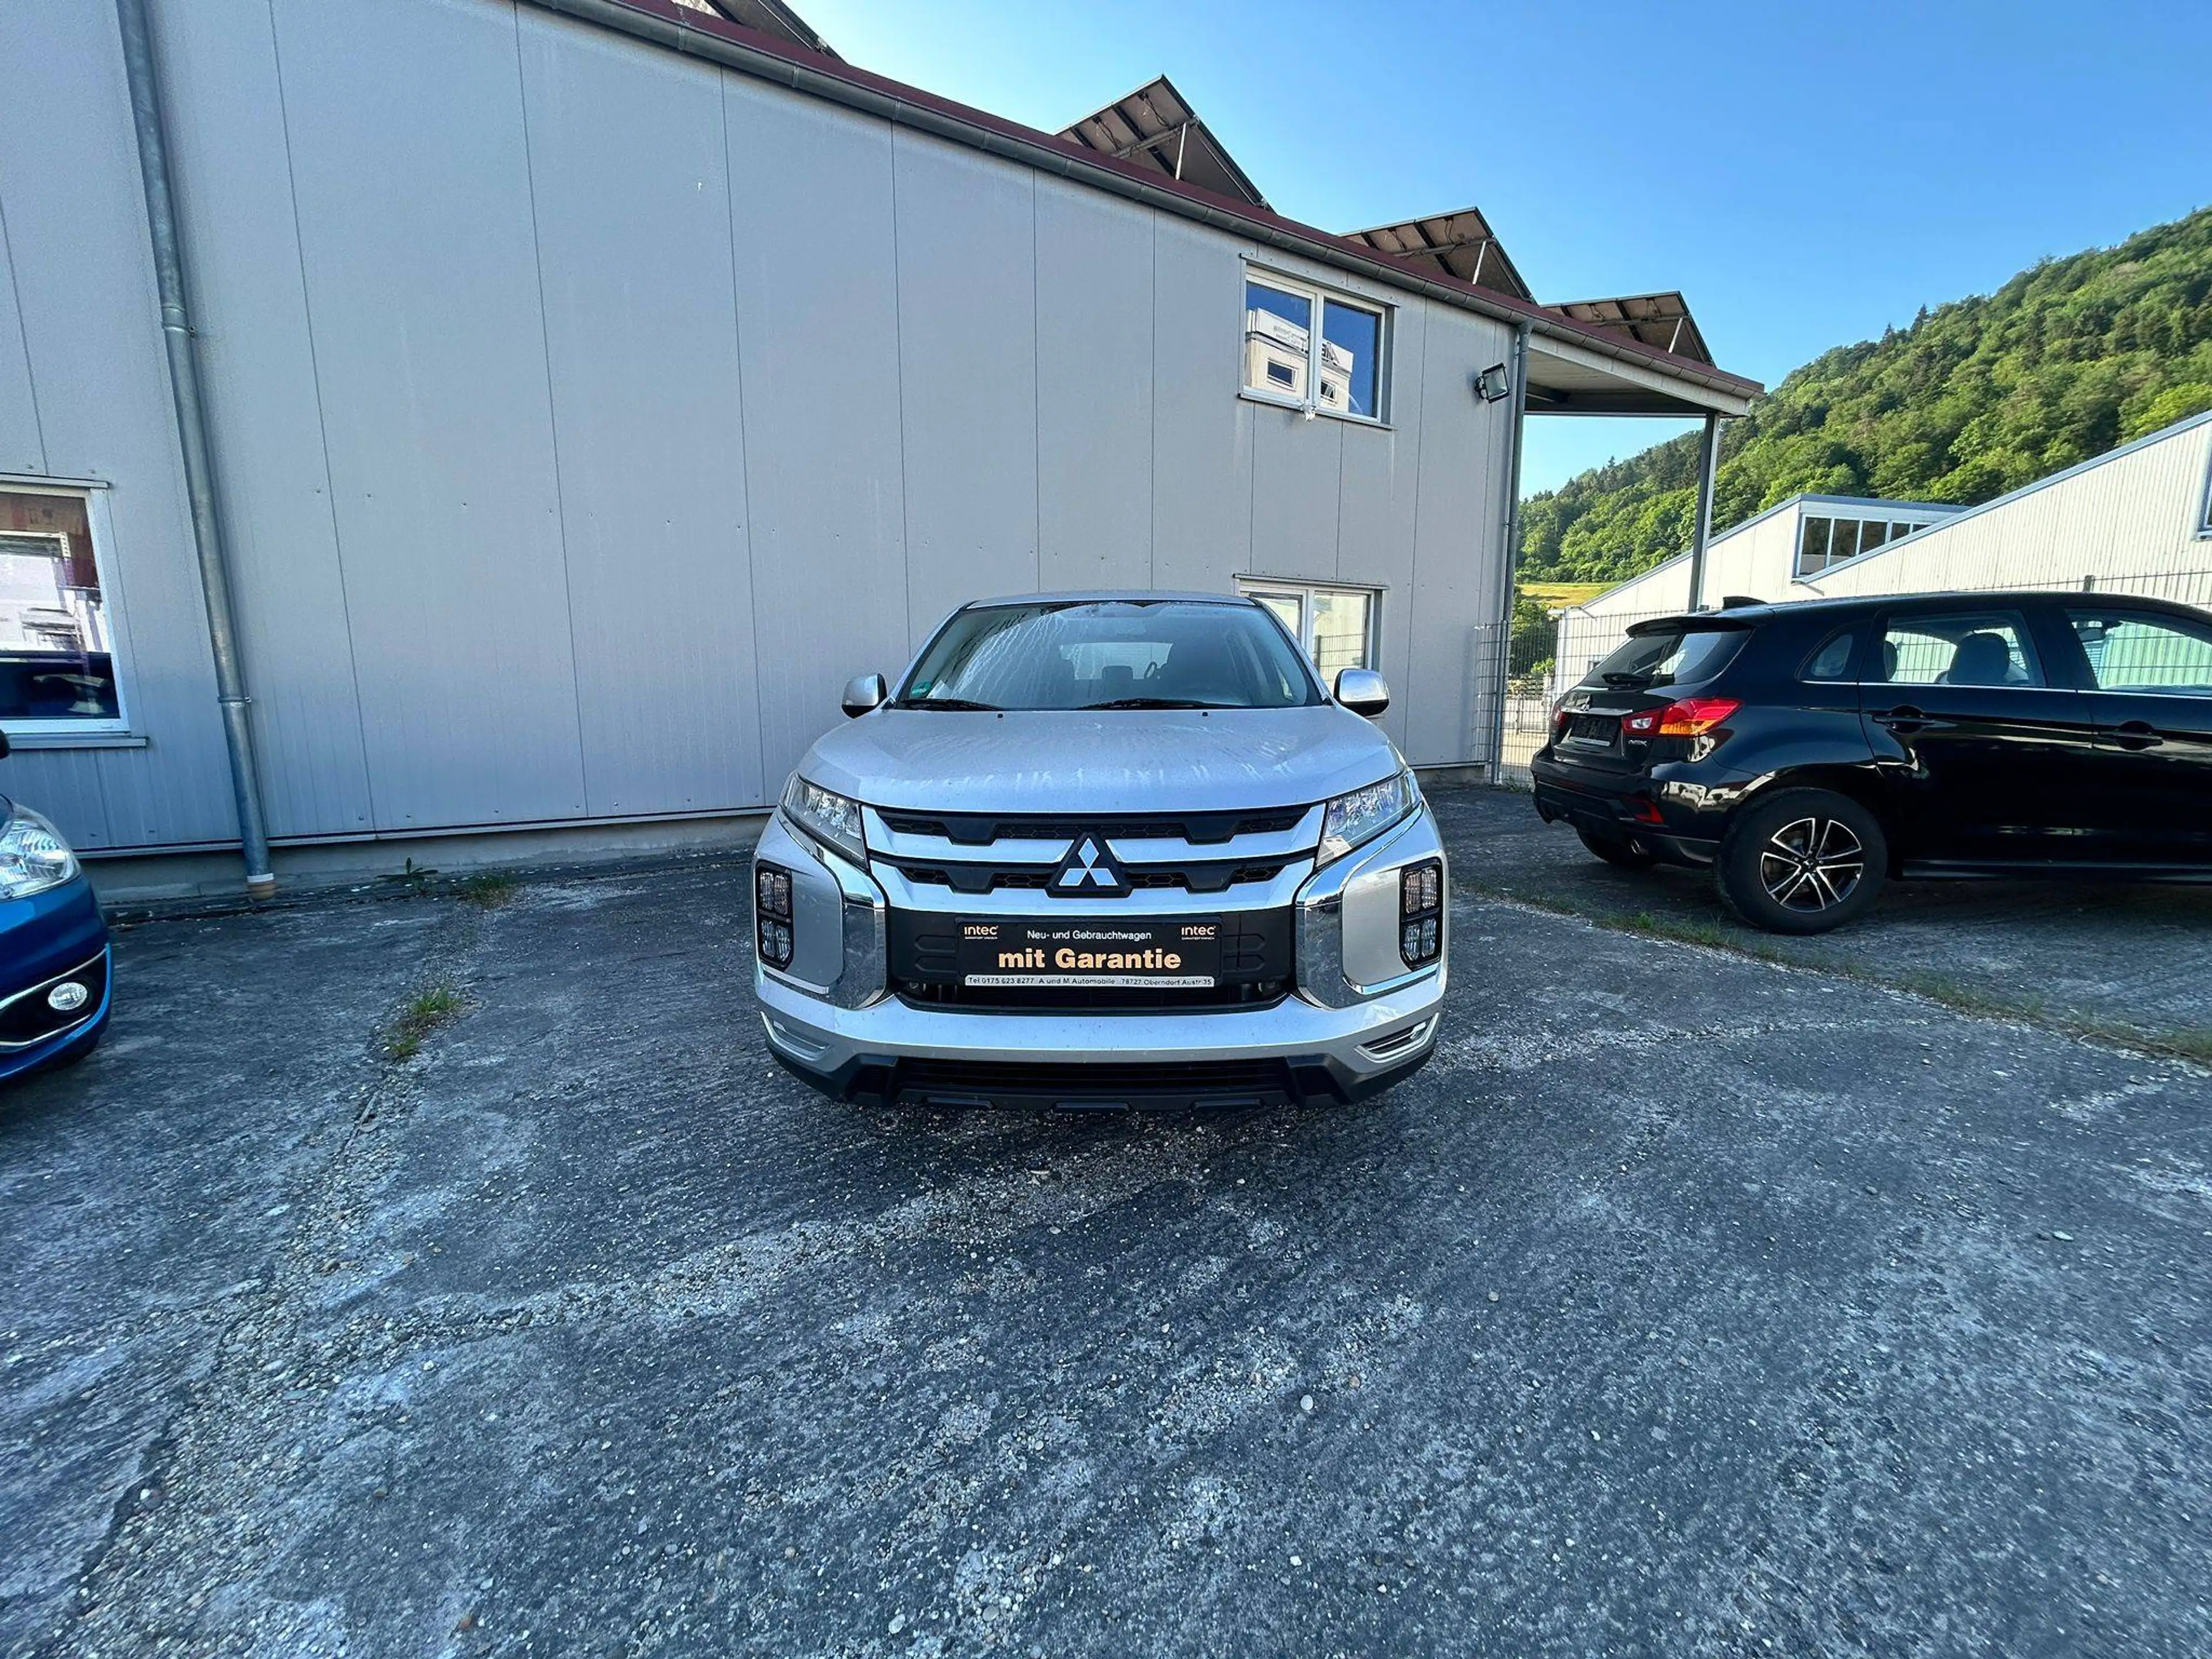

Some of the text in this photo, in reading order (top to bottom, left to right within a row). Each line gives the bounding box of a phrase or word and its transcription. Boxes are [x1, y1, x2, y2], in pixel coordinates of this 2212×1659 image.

[964, 925, 998, 935] intec
[1181, 926, 1215, 935] intec
[1027, 930, 1152, 941] Neu- und Gebrauchtwagen
[998, 948, 1181, 969] mit Garantie
